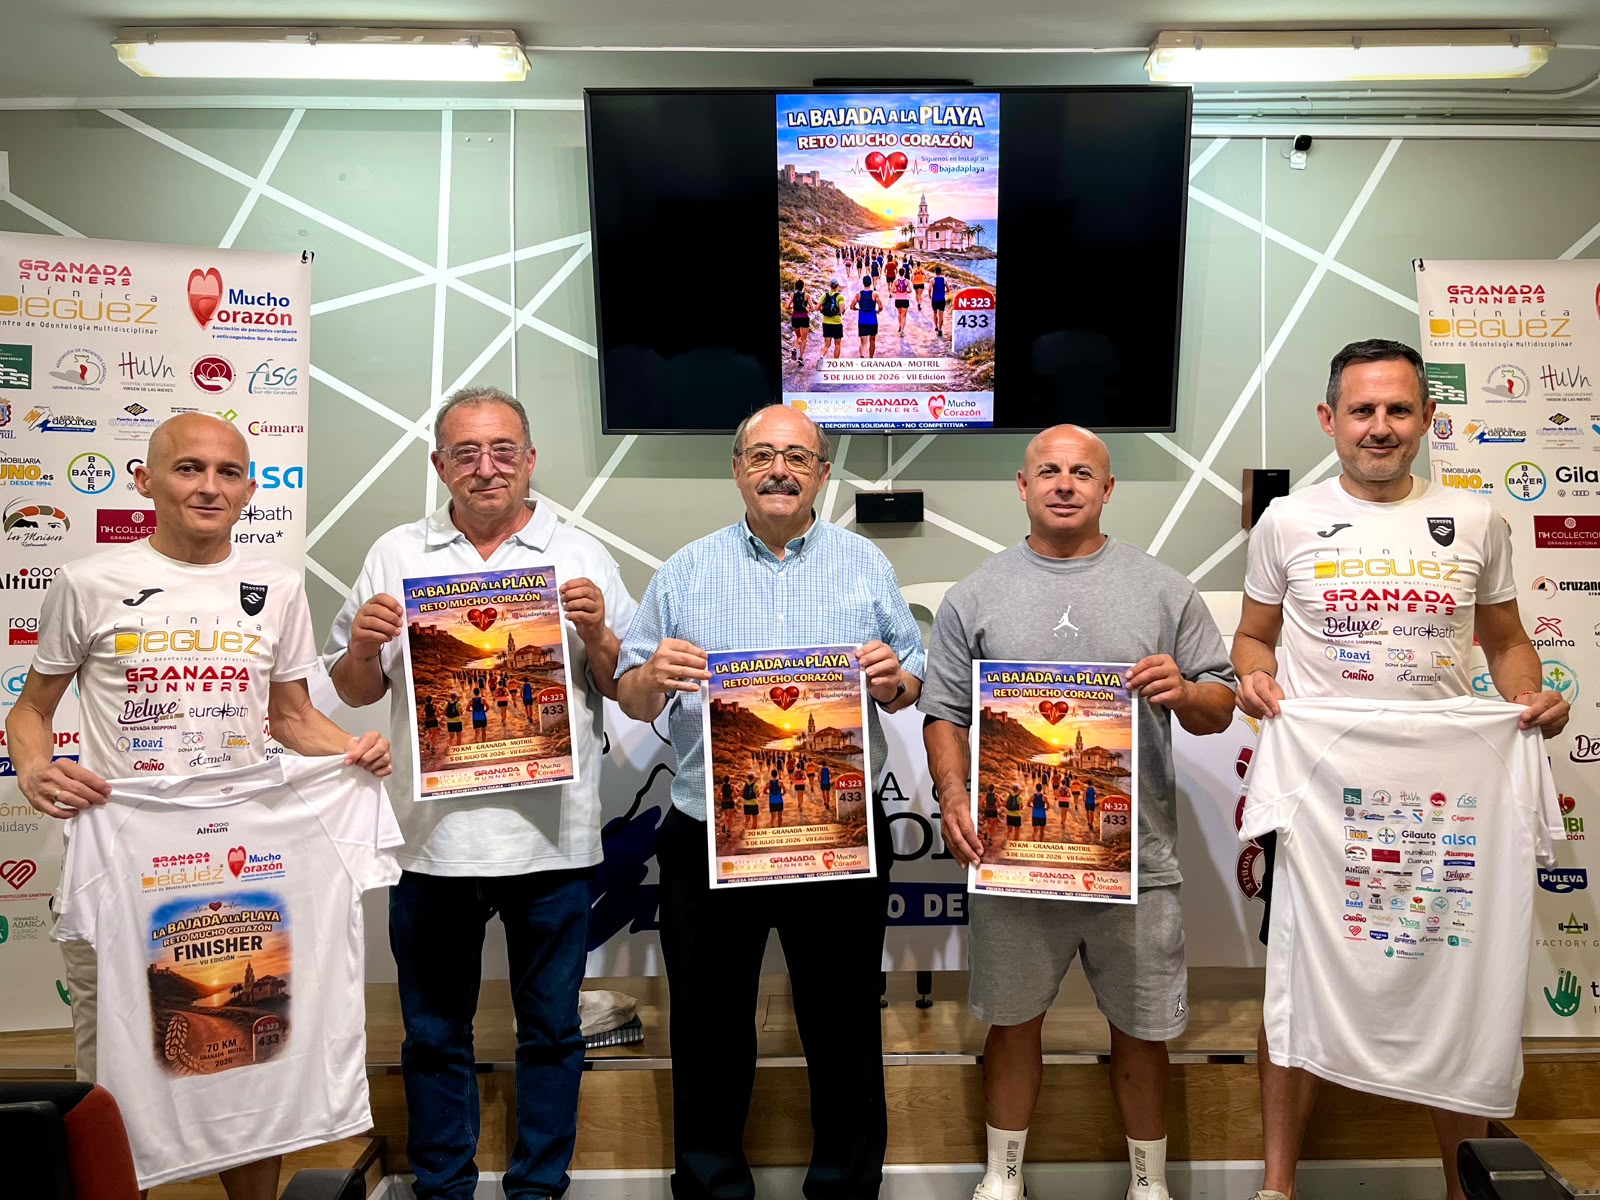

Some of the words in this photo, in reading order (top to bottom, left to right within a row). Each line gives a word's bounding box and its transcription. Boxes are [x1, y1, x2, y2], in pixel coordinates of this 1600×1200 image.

[787, 112, 808, 127] LA
[809, 107, 886, 127] BAJADA
[888, 110, 899, 122] A
[900, 110, 917, 122] LA
[919, 105, 985, 127] PLAYA
[798, 134, 838, 149] RETO
[841, 133, 898, 148] MUCHO
[900, 131, 974, 148] CORAZÓN
[958, 155, 989, 163] Instagram
[939, 165, 985, 173] bajadaplaya
[18, 258, 132, 278] GRANADA
[19, 271, 131, 287] RUNNERS
[1447, 284, 1546, 296] GRANADA
[228, 288, 290, 308] Mucho
[957, 297, 991, 307] N-323
[1449, 296, 1545, 305] RUNNERS
[1428, 308, 1570, 317] clínica
[957, 314, 989, 328] 433
[40, 321, 91, 332] Odontología
[93, 325, 158, 335] Multidisciplinar
[826, 360, 837, 368] 70
[839, 360, 853, 368] KM
[860, 360, 902, 368] GRANADA
[907, 360, 941, 368] MOTRIL
[842, 373, 865, 381] JULIO
[878, 373, 900, 381] 2026
[918, 372, 946, 381] Edición
[856, 398, 919, 406] GRANADA
[947, 399, 976, 408] Mucho
[943, 407, 981, 416] Corazón
[52, 416, 97, 427] deportes
[248, 421, 304, 436] Cámara
[1487, 429, 1527, 437] deportes
[71, 469, 111, 477] BAYER
[249, 461, 303, 489] lsa
[1442, 474, 1483, 489] UNO
[1551, 531, 1600, 539] COLLECTIO
[411, 588, 425, 599] LA
[426, 581, 480, 598] BAJADA
[480, 582, 488, 590] A
[488, 582, 501, 590] LA
[502, 575, 547, 589] PLAYA
[419, 602, 448, 613] RETO
[449, 597, 489, 608] MUCHO
[490, 592, 541, 604] CORAZÓN
[1322, 588, 1457, 606] GRANADA
[1325, 602, 1456, 616] RUNNERS
[1322, 615, 1383, 638] Deluxe
[1338, 648, 1371, 660] Roavi
[715, 664, 730, 674] LA
[730, 658, 783, 674] BAJADA
[784, 660, 792, 668] A
[792, 659, 805, 667] LA
[805, 654, 850, 668] PLAYA
[125, 665, 249, 682] GRANADA
[986, 673, 1000, 683] LA
[1001, 671, 1054, 684] BAJADA
[1054, 674, 1062, 682] A
[1063, 674, 1076, 683] LA
[1076, 672, 1122, 687] PLAYA
[1341, 669, 1375, 682] CARIÑO
[722, 678, 751, 689] RETO
[752, 674, 792, 685] MUCHO
[793, 671, 844, 683] CORAZÓN
[127, 682, 248, 694] RUNNERS
[993, 688, 1021, 698] RETO
[1022, 688, 1062, 699] MUCHO
[1063, 688, 1114, 701] CORAZÓN
[117, 698, 180, 724] Deluxe
[542, 705, 565, 715] 433
[132, 736, 163, 748] Roavi
[133, 757, 165, 772] CARIÑO
[474, 766, 520, 777] GRANADA
[839, 780, 862, 788] N-323
[839, 791, 862, 802] 433
[1104, 803, 1128, 811] N-323
[1103, 814, 1127, 825] 433
[196, 826, 229, 836] Altium
[1401, 830, 1437, 840] Gilauto
[1441, 833, 1477, 846] alsa
[248, 853, 282, 864] Mucho
[769, 855, 816, 864] GRANADA
[1029, 871, 1076, 880] GRANADA
[1240, 852, 1253, 891] NOBLE
[1540, 873, 1585, 883] PULEVA
[12, 920, 47, 929] ABARCA
[152, 929, 166, 941] LA
[166, 914, 221, 935] BAJADA
[222, 916, 229, 924] A
[229, 914, 240, 923] LA
[241, 911, 281, 923] PLAYA
[163, 934, 188, 947] RETO
[189, 927, 225, 941] MUCHO
[227, 922, 272, 934] CORAZÓN
[174, 935, 263, 962] FINISHER
[1535, 939, 1588, 947] FACTORY
[210, 955, 235, 964] EDICIÓN
[206, 1041, 219, 1053] 70
[222, 1038, 237, 1050] KM
[258, 1033, 280, 1047] 433
